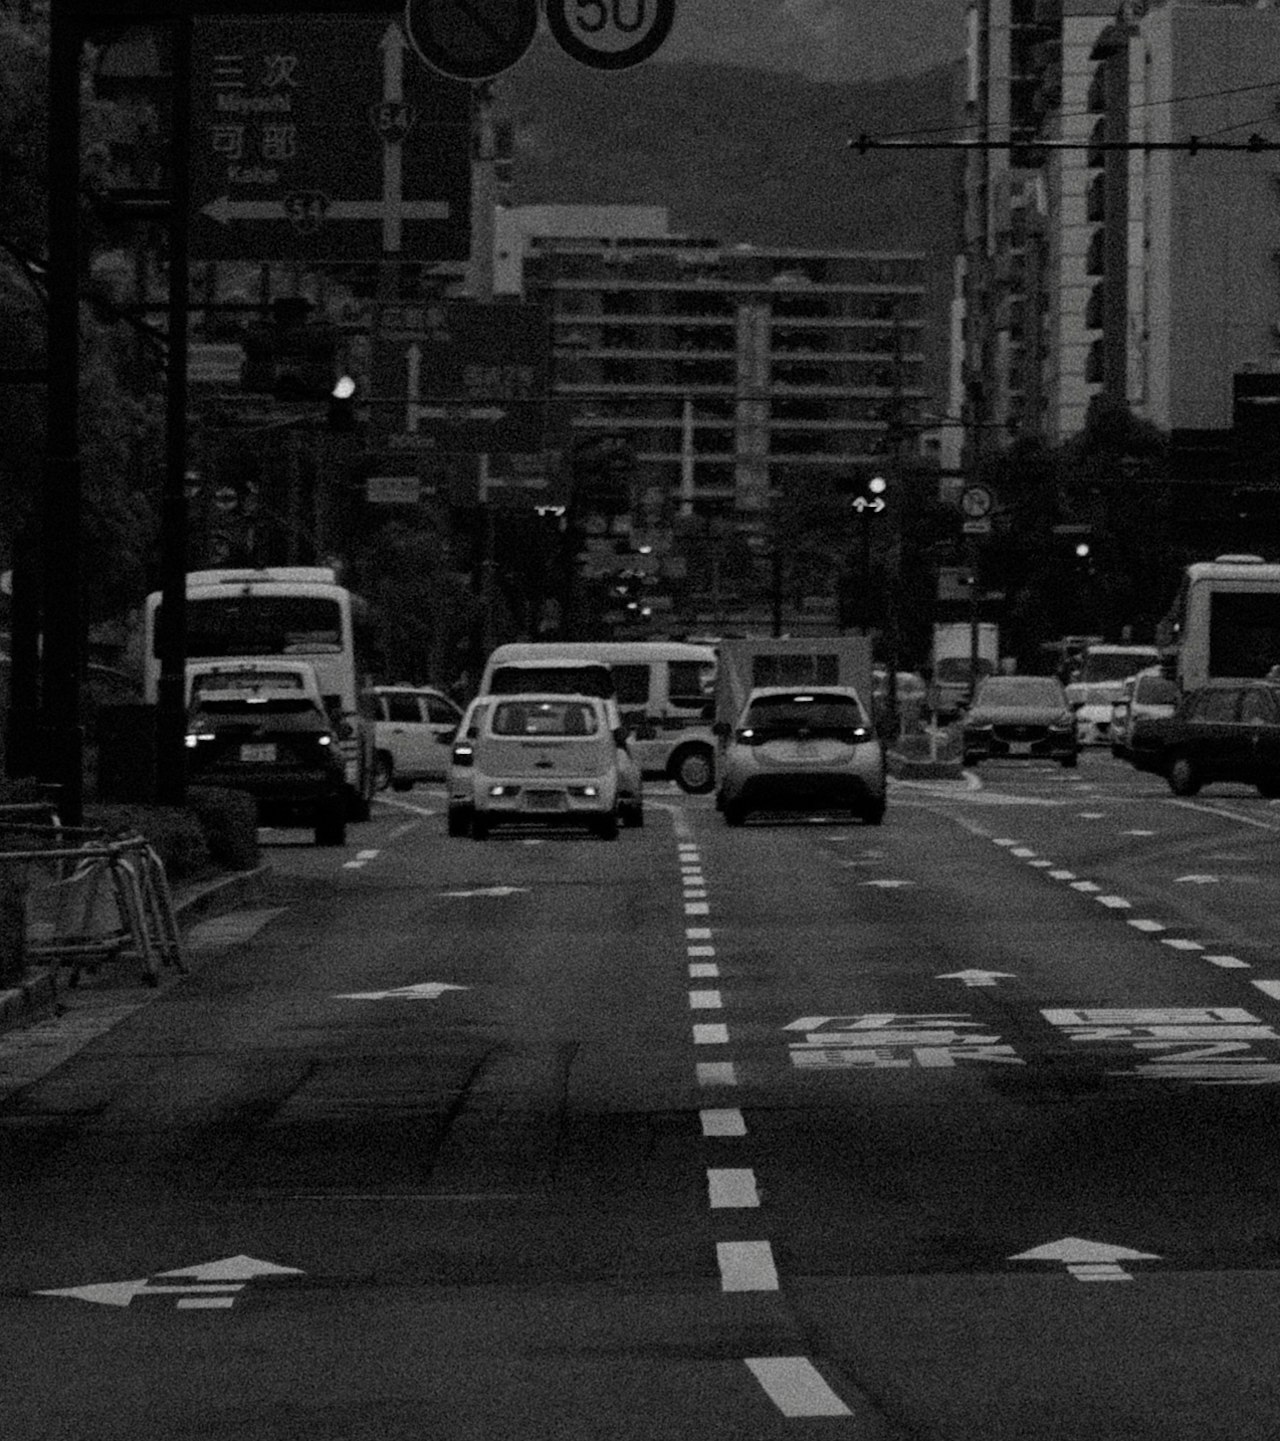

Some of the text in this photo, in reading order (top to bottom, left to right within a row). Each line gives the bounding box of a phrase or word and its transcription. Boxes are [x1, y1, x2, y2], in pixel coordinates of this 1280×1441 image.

[210, 53, 299, 88] 三次
[378, 111, 408, 131] 54
[211, 123, 297, 160] 可部
[227, 165, 279, 185] Kabe
[292, 197, 321, 215] 54
